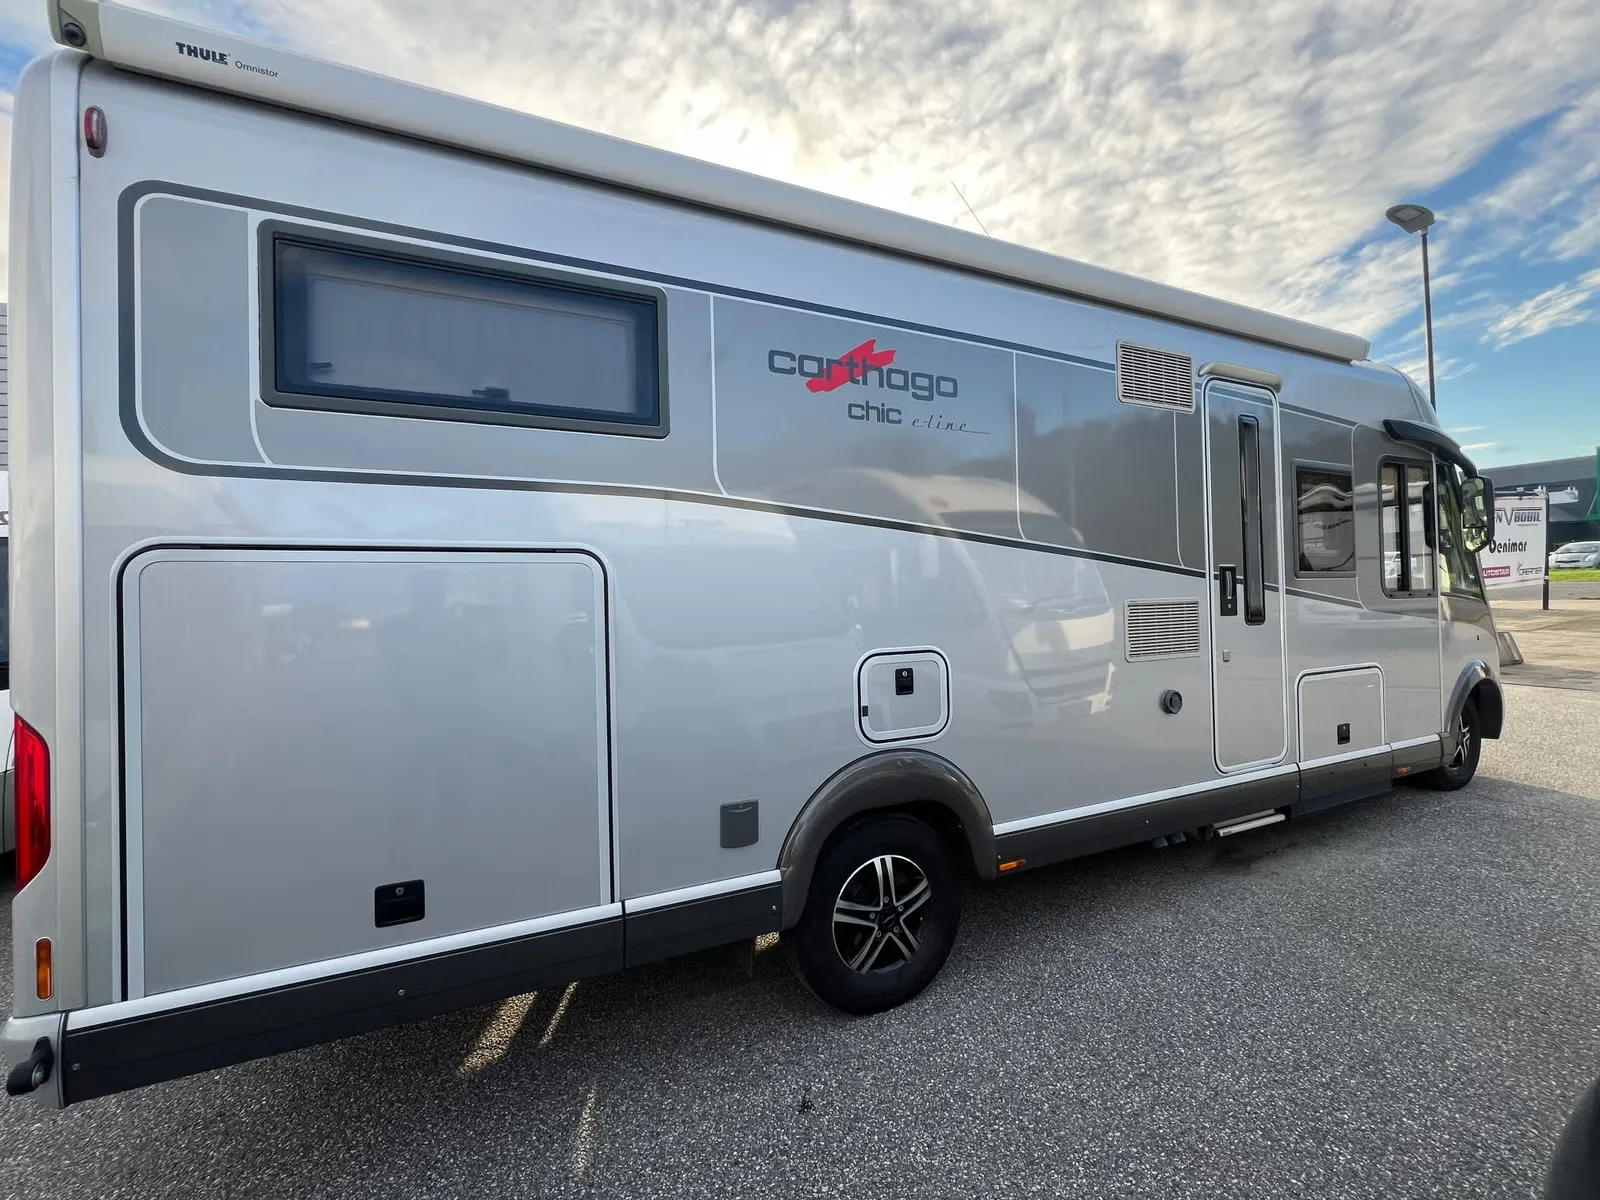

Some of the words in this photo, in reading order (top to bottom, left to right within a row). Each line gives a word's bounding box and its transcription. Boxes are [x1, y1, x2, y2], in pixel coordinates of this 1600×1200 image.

[176, 42, 228, 65] THULE
[235, 60, 279, 78] Omnistor
[768, 349, 959, 402] carthago
[847, 400, 903, 425] chic
[911, 414, 990, 435] e-line
[1484, 568, 1510, 577] UTOSTAR
